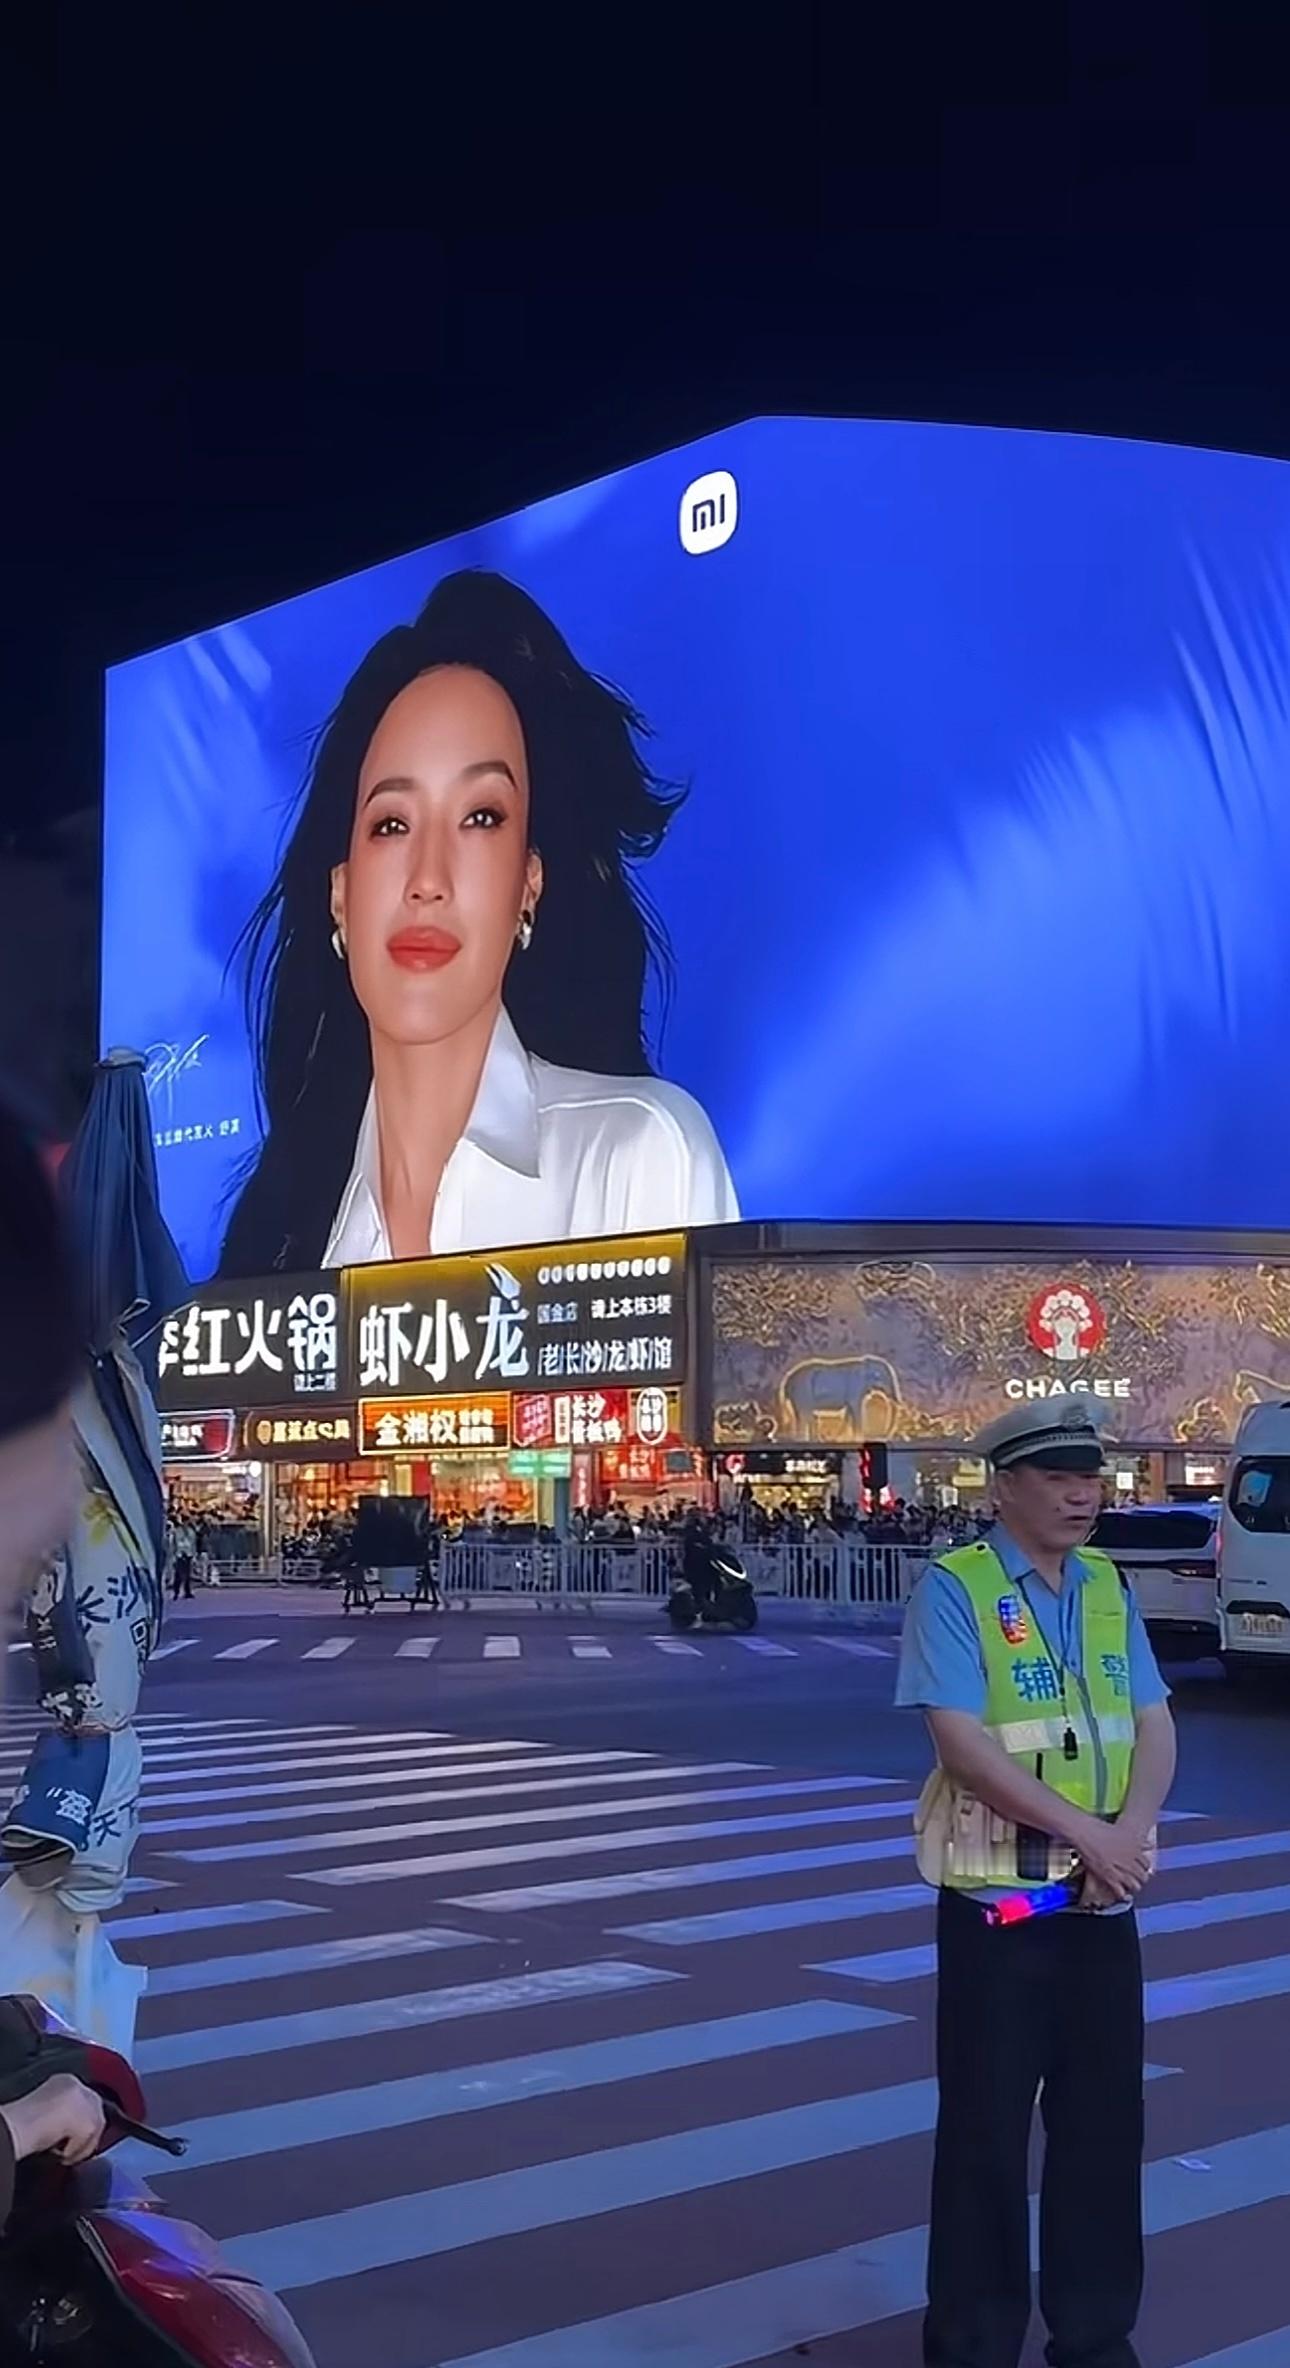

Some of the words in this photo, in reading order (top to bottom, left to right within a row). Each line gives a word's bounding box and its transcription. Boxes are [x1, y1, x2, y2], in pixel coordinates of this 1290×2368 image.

[359, 1297, 530, 1387] 虾小龙
[1004, 1378, 1132, 1399] CHAGEE
[1011, 1657, 1058, 1702] 辅
